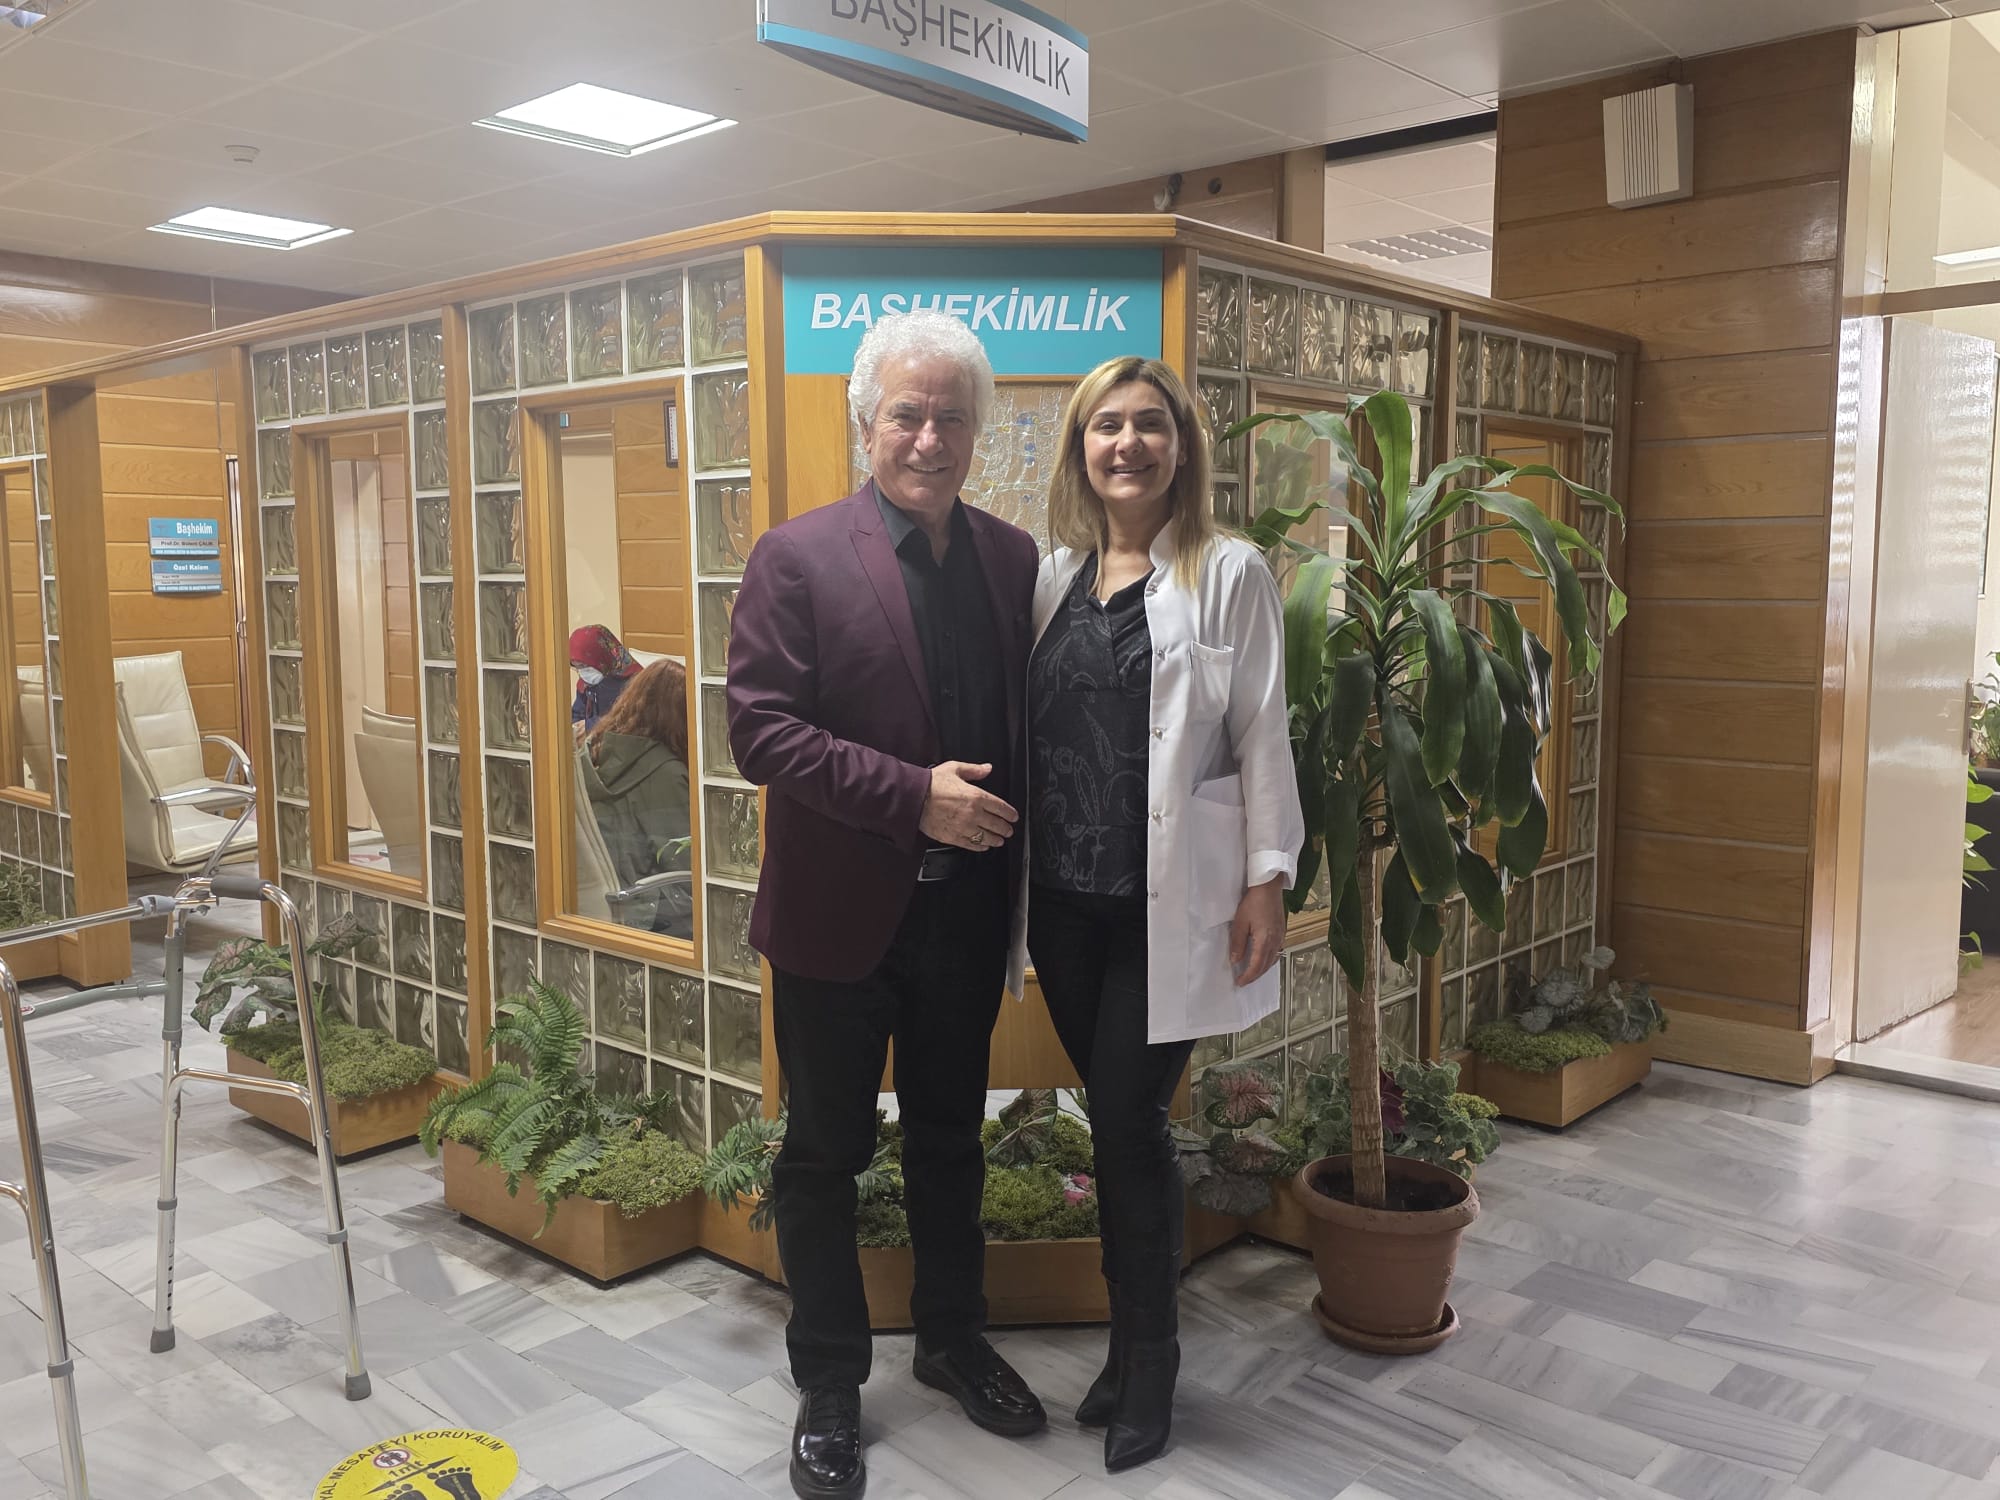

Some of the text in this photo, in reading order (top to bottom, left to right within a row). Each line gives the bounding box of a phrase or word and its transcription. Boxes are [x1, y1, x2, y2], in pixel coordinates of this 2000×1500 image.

[176, 521, 213, 537] Başhekim
[189, 563, 209, 571] Kalem
[413, 1431, 504, 1452] KORUYALIM
